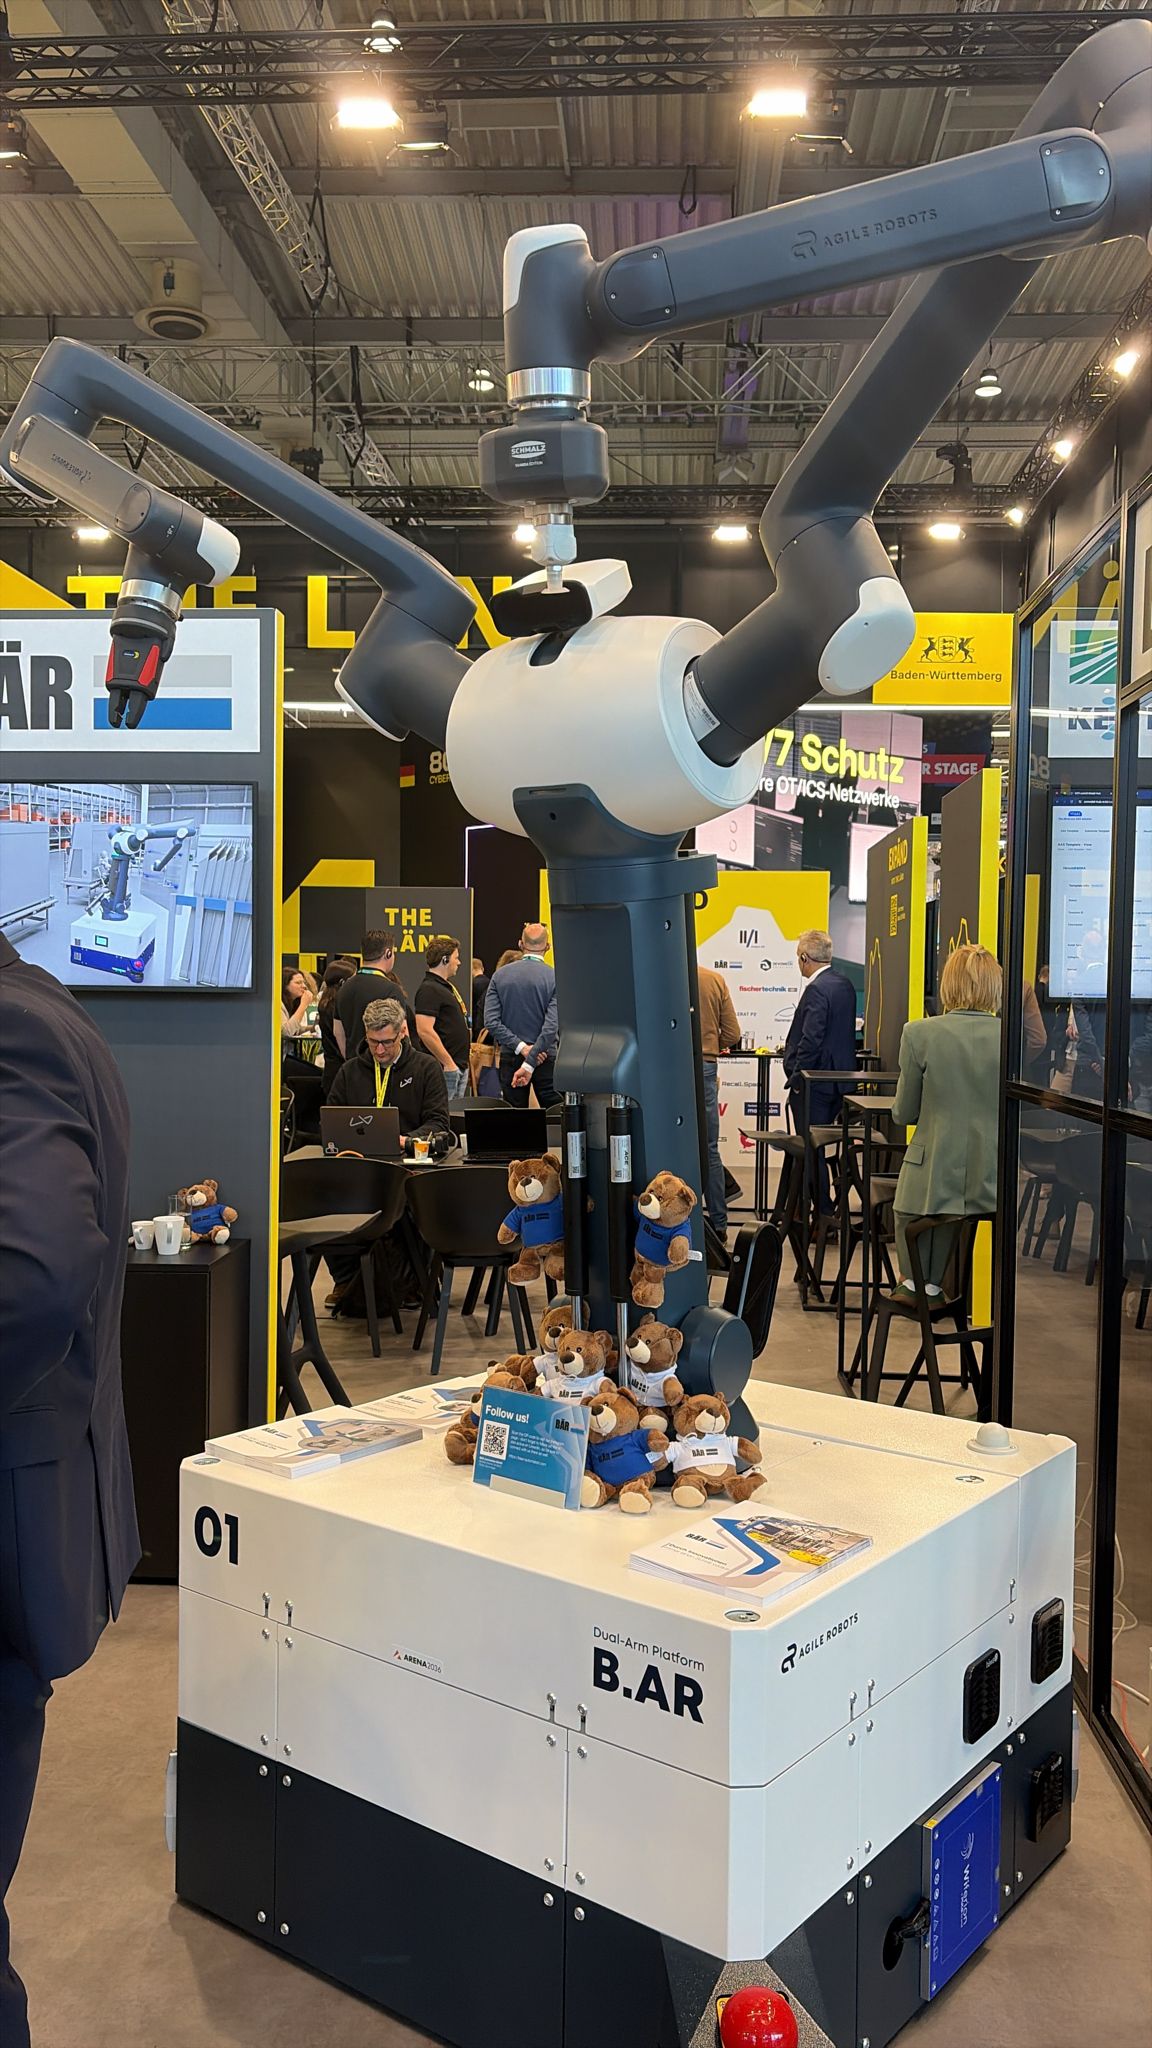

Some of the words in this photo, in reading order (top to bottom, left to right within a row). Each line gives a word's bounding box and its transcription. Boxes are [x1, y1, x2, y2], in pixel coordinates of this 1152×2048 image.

[824, 225, 870, 247] AGILE
[874, 208, 938, 236] ROBOTS
[511, 445, 546, 455] SCHMALZ
[890, 670, 1002, 682] Baden-Württemberg
[800, 733, 904, 785] Schutz
[934, 763, 978, 775] STAGE
[776, 776, 900, 809] OT/ICS-Netzwerke
[385, 908, 432, 926] THE
[714, 960, 728, 968] BÄR
[739, 985, 786, 993] fischertechnik
[485, 1404, 514, 1420] Follow
[515, 1412, 529, 1424] us!
[555, 1418, 570, 1431] BÄR
[194, 1505, 239, 1566] 01
[798, 1634, 824, 1660] AGILE
[826, 1612, 859, 1642] ROBOTS
[593, 1626, 649, 1654] Dual-Arm
[652, 1645, 705, 1672] Platform
[593, 1646, 704, 1725] B.AR
